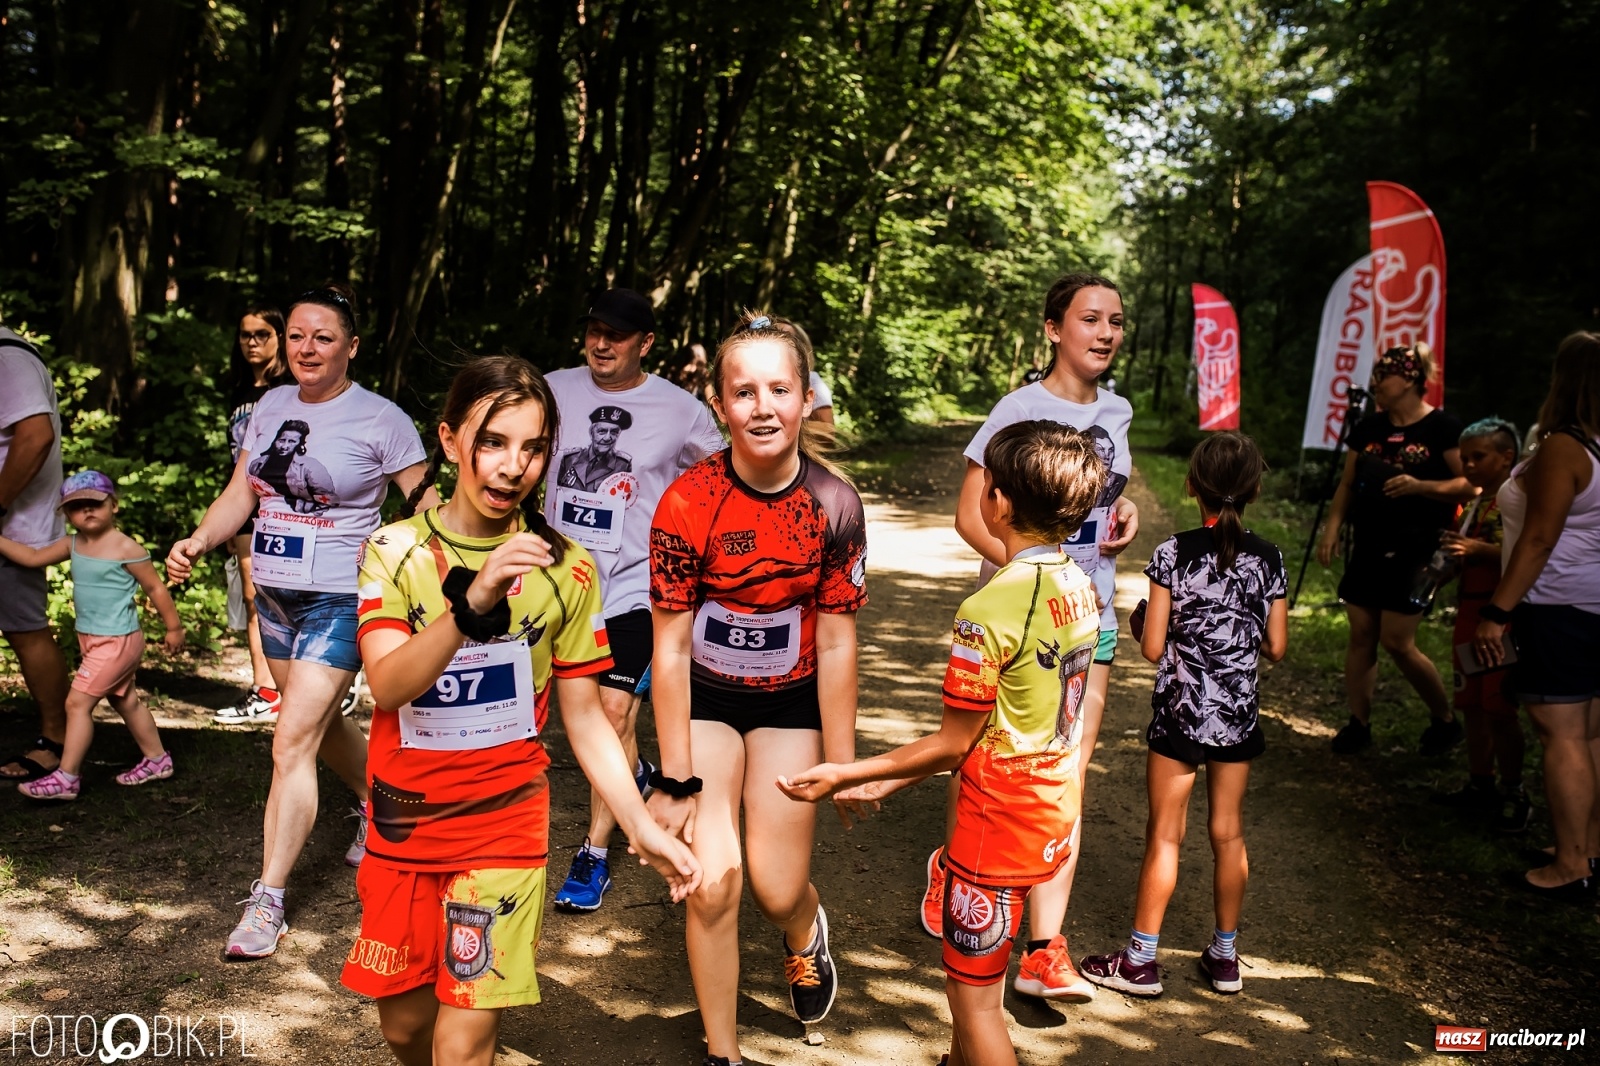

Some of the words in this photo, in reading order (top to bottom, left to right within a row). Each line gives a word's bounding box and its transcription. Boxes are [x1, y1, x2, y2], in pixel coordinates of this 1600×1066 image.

[573, 507, 597, 525] 74
[263, 535, 286, 554] 73
[723, 539, 756, 555] RACE
[728, 628, 766, 648] 83
[436, 671, 484, 703] 97
[485, 704, 500, 712] godz.
[502, 700, 518, 708] 11.00
[954, 930, 980, 950] OCR
[348, 937, 409, 976] JULIA
[454, 962, 471, 975] OCR
